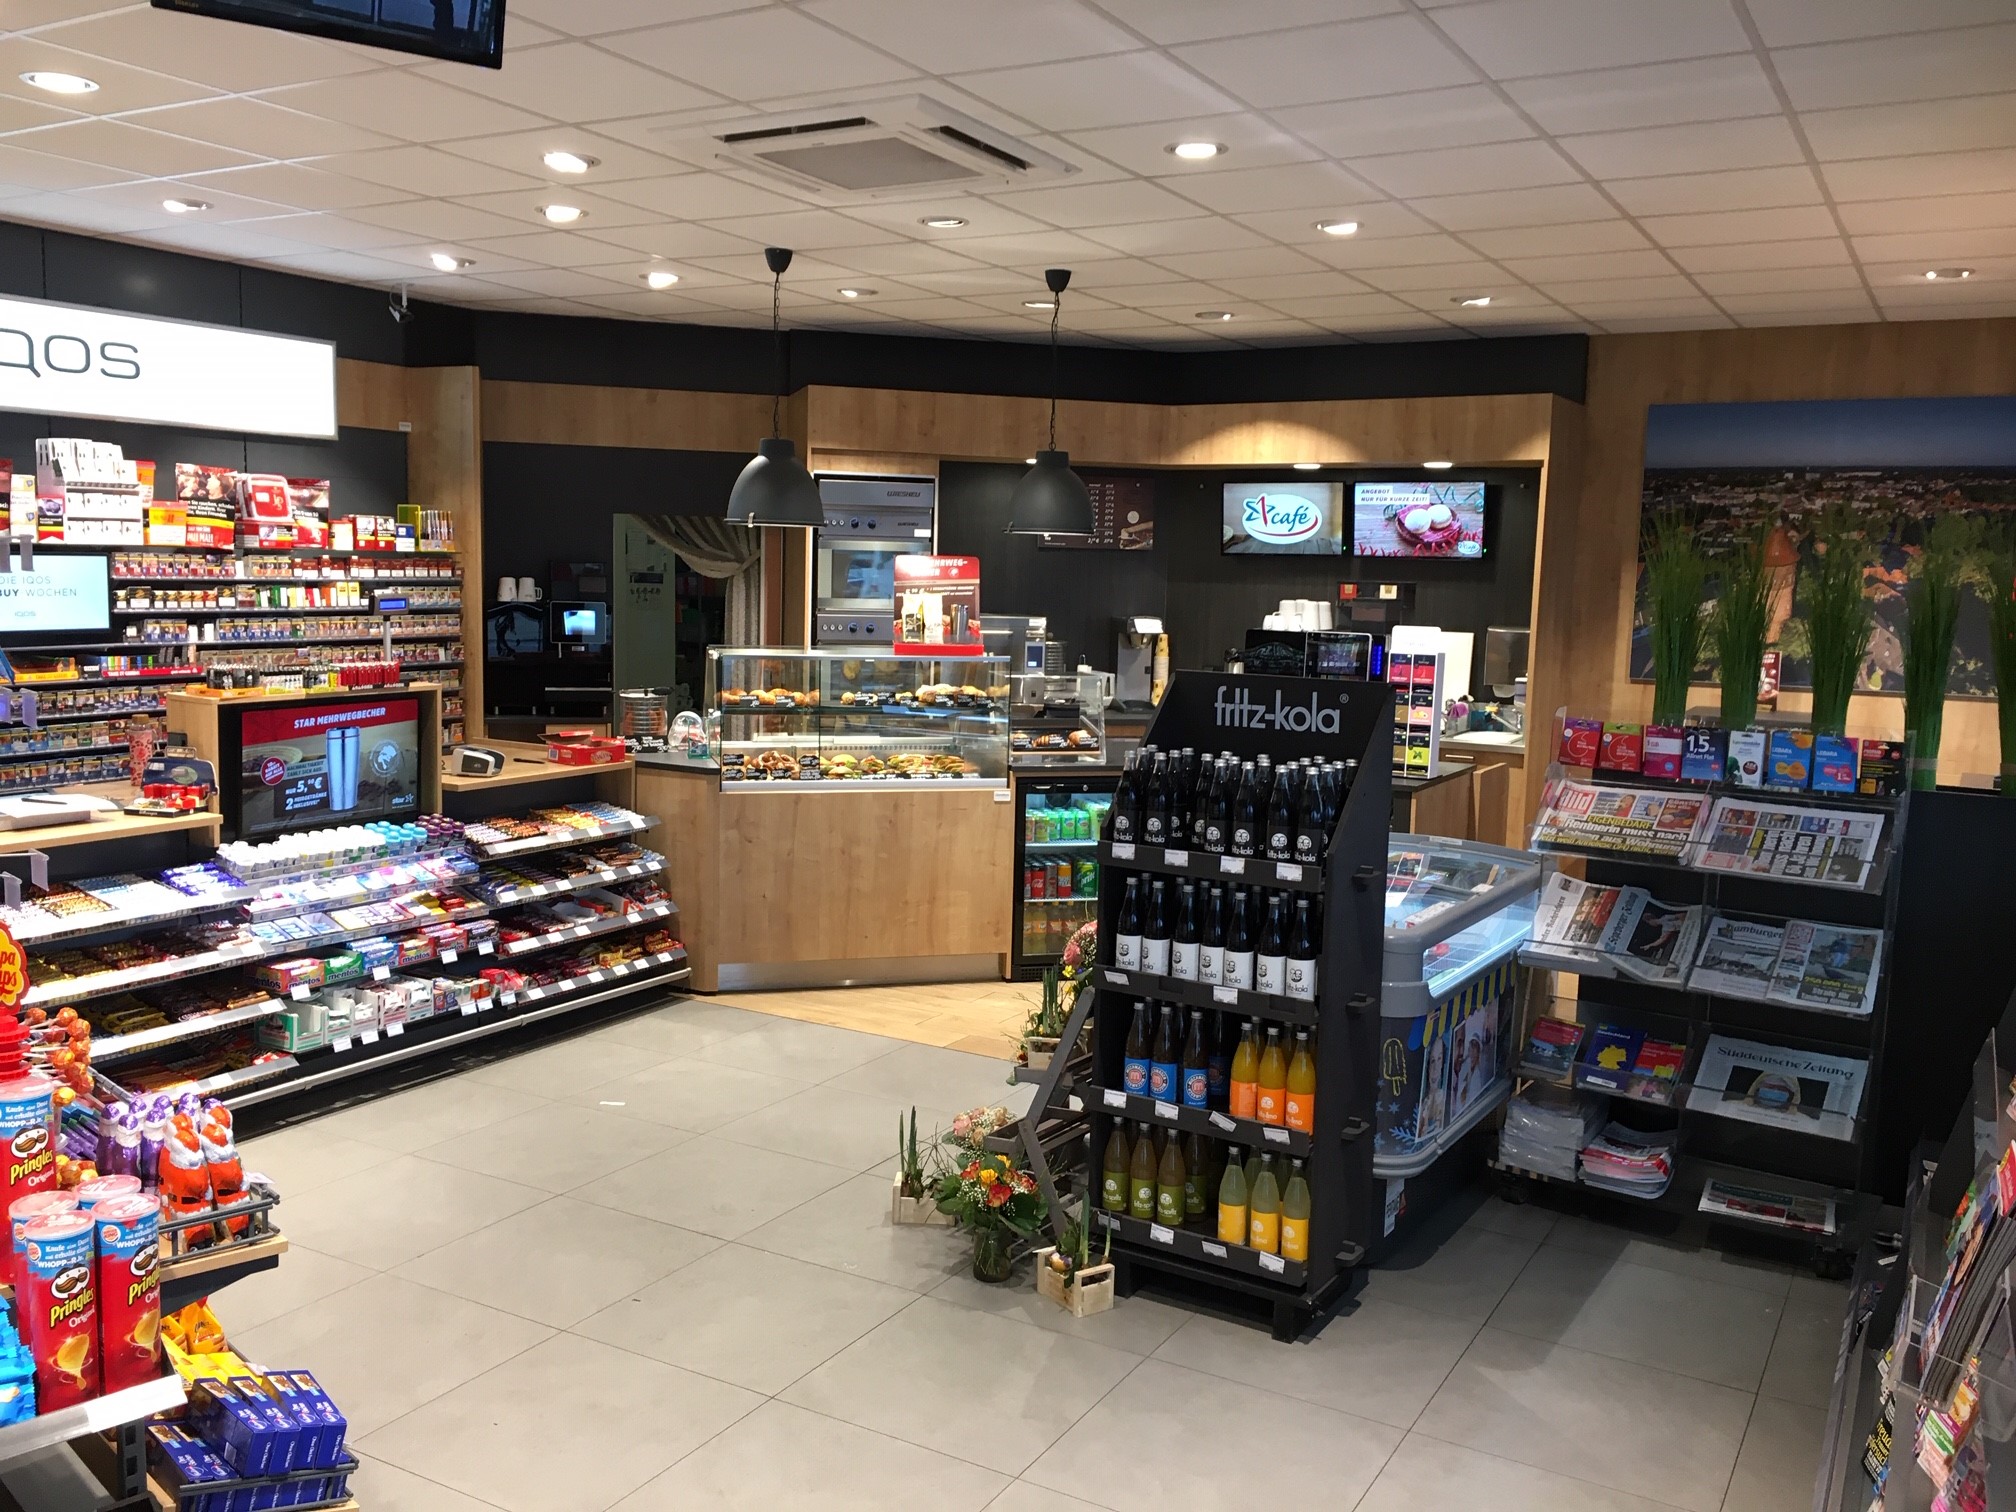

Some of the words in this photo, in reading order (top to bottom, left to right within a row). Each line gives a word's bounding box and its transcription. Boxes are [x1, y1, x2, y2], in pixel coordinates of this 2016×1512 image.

[1271, 505, 1310, 532] café
[22, 576, 51, 585] IQOS
[25, 588, 77, 597] WOCHEN
[294, 718, 315, 729] STAR
[317, 707, 386, 725] MEHRWEGBECHER
[1686, 735, 1710, 753] 1,5
[285, 797, 294, 811] 2
[1587, 815, 1652, 829] EIGENBEDARF
[1565, 819, 1617, 834] Rentnerin
[1622, 826, 1655, 838] muss
[1657, 829, 1687, 841] nach
[403, 952, 430, 963] mentos
[328, 968, 359, 981] mentos
[1717, 1046, 1801, 1069] Süddeutsche
[1802, 1060, 1855, 1081] Zeitung
[5, 1105, 24, 1113] Kaufe
[14, 1111, 35, 1119] erhalte
[10, 1149, 53, 1186] Pringles
[28, 1166, 55, 1187] Original
[45, 1244, 65, 1253] Kaufe
[55, 1249, 76, 1259] erhalte
[50, 1288, 94, 1328] Pringles
[69, 1304, 95, 1328] Original
